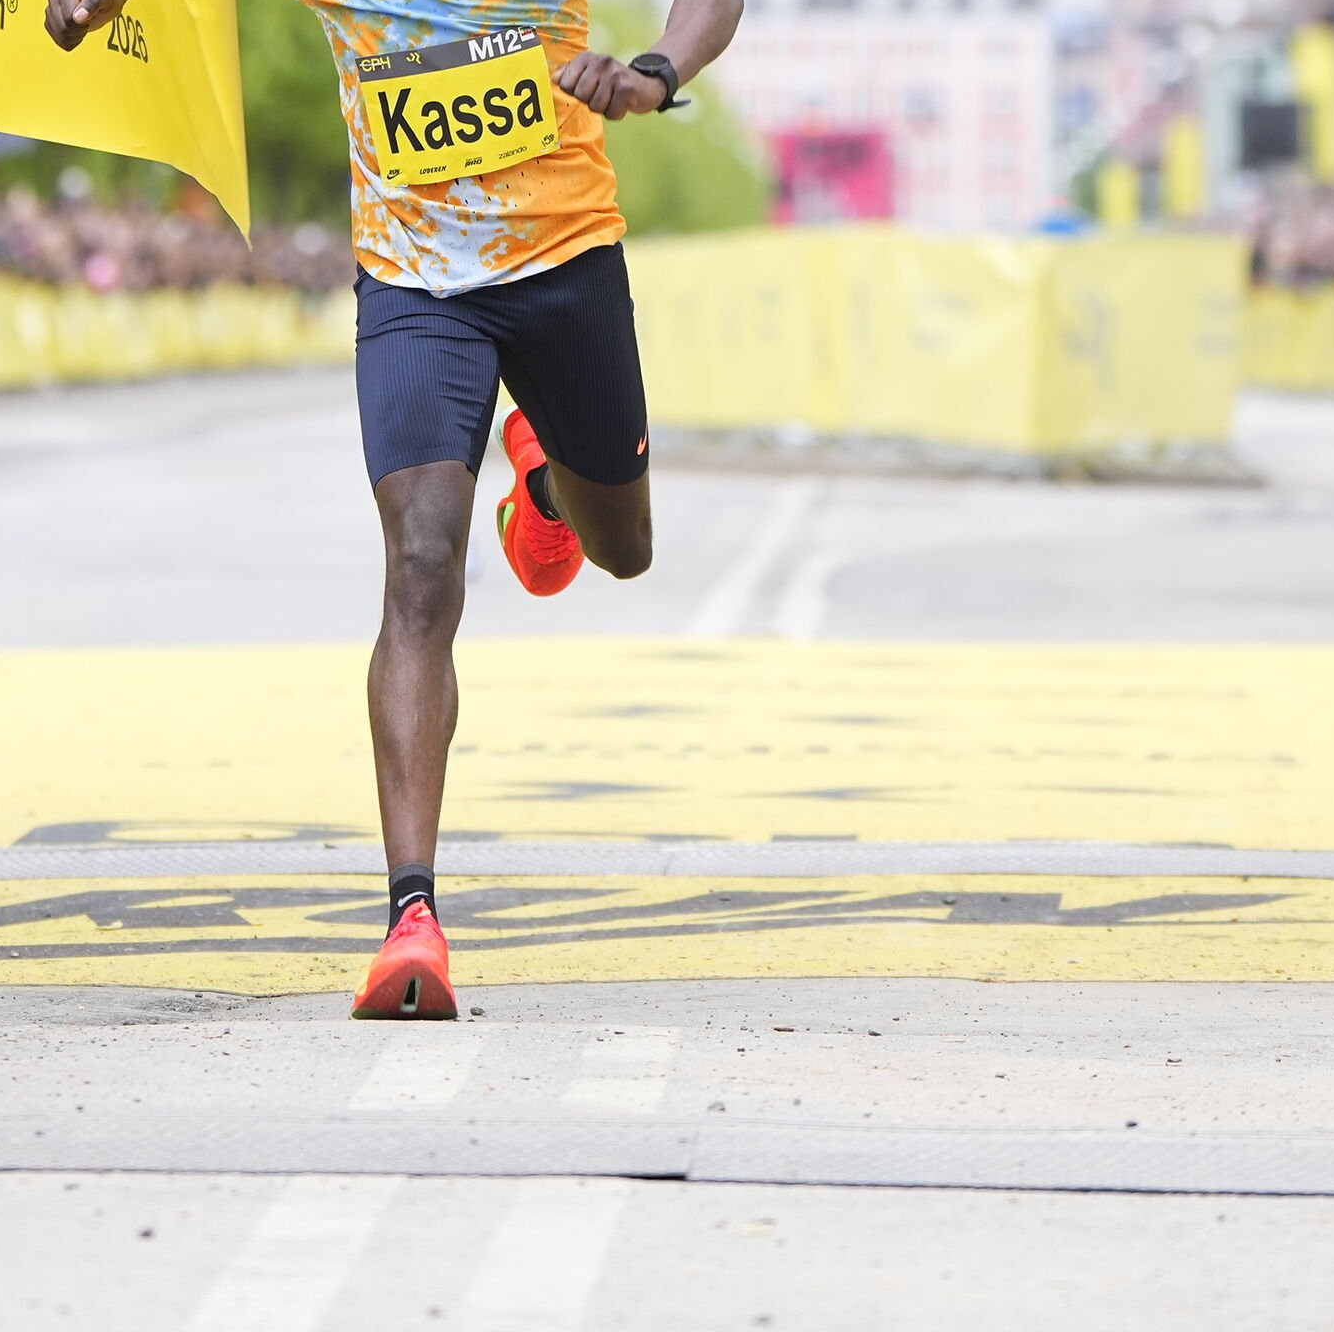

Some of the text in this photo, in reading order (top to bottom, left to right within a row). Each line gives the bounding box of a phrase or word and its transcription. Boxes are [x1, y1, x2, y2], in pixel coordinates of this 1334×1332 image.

[108, 13, 149, 64] 2026
[361, 56, 391, 72] CPH
[377, 78, 544, 154] Kassa
